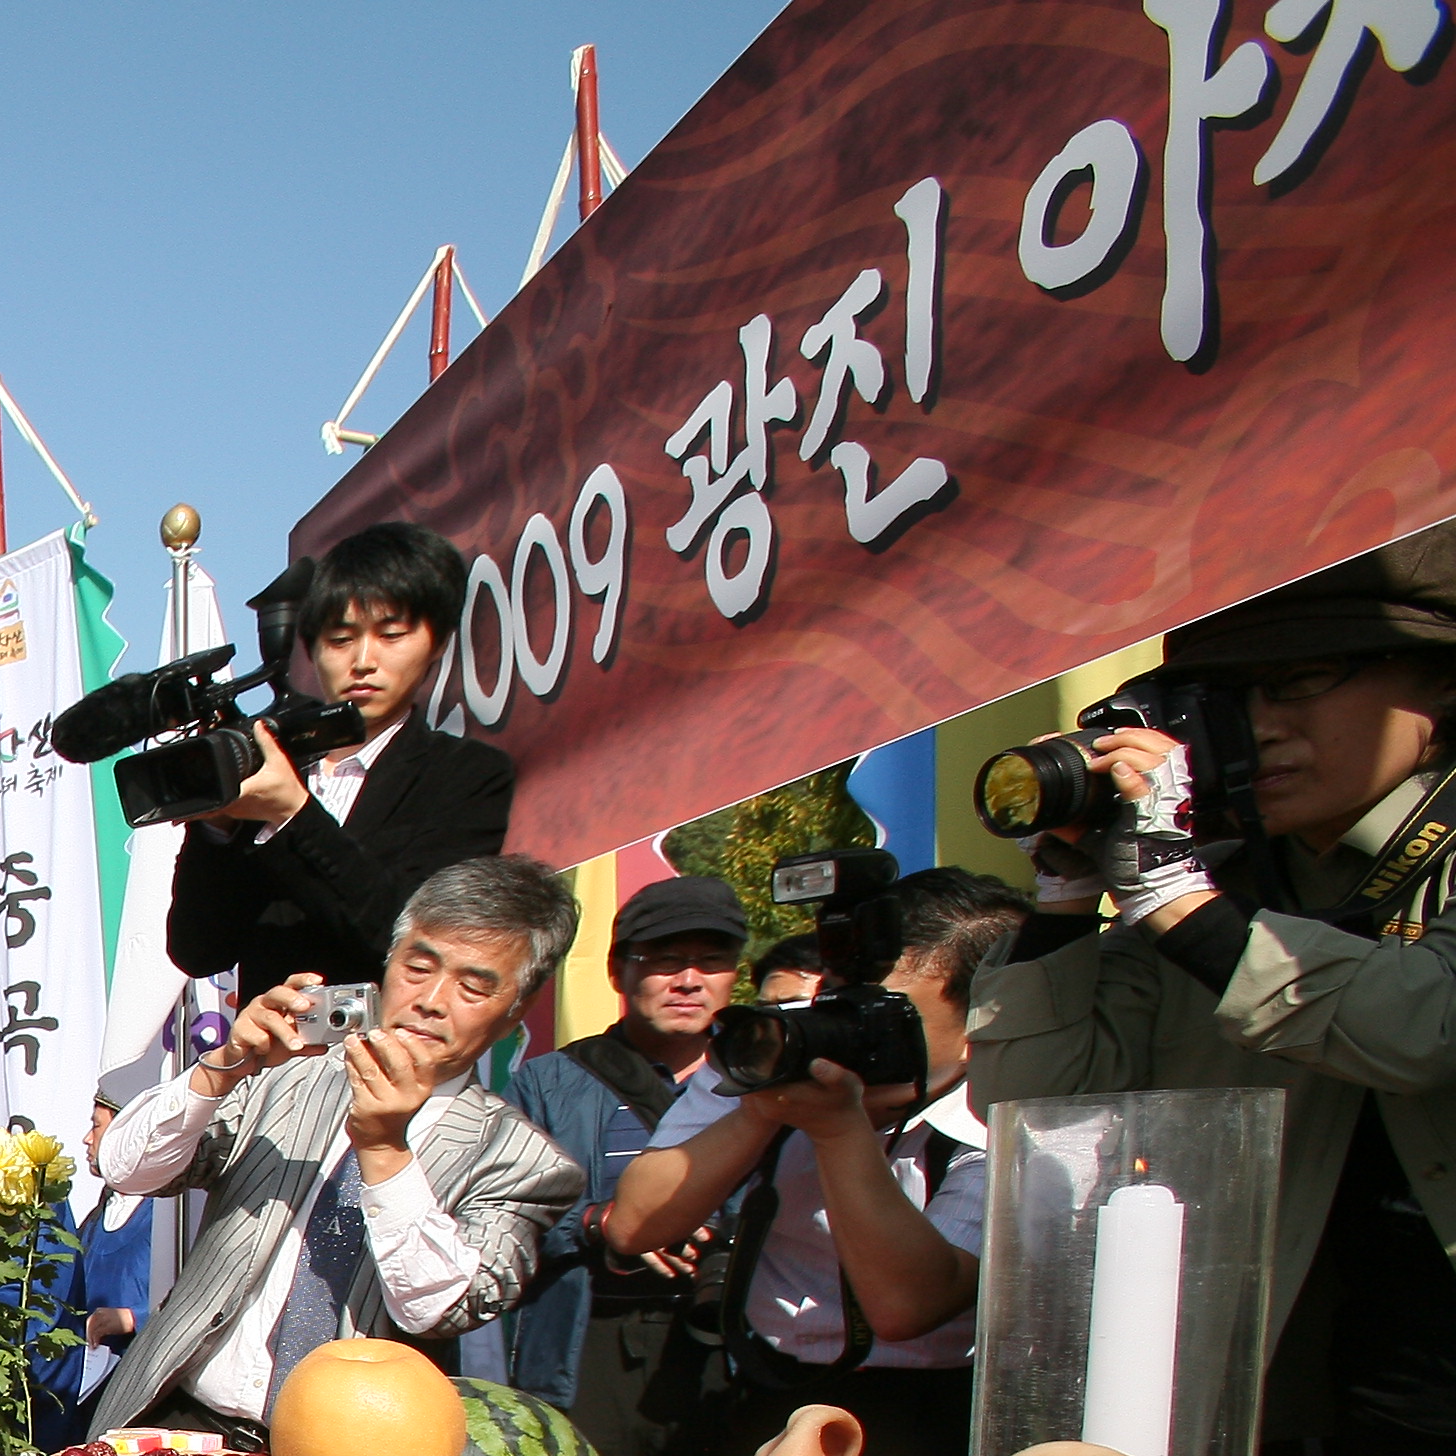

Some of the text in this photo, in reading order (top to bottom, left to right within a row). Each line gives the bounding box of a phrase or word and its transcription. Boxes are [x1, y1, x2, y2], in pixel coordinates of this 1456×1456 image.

[664, 176, 948, 619] 광진
[24, 763, 63, 798] 축제
[1361, 821, 1447, 900] Nikon
